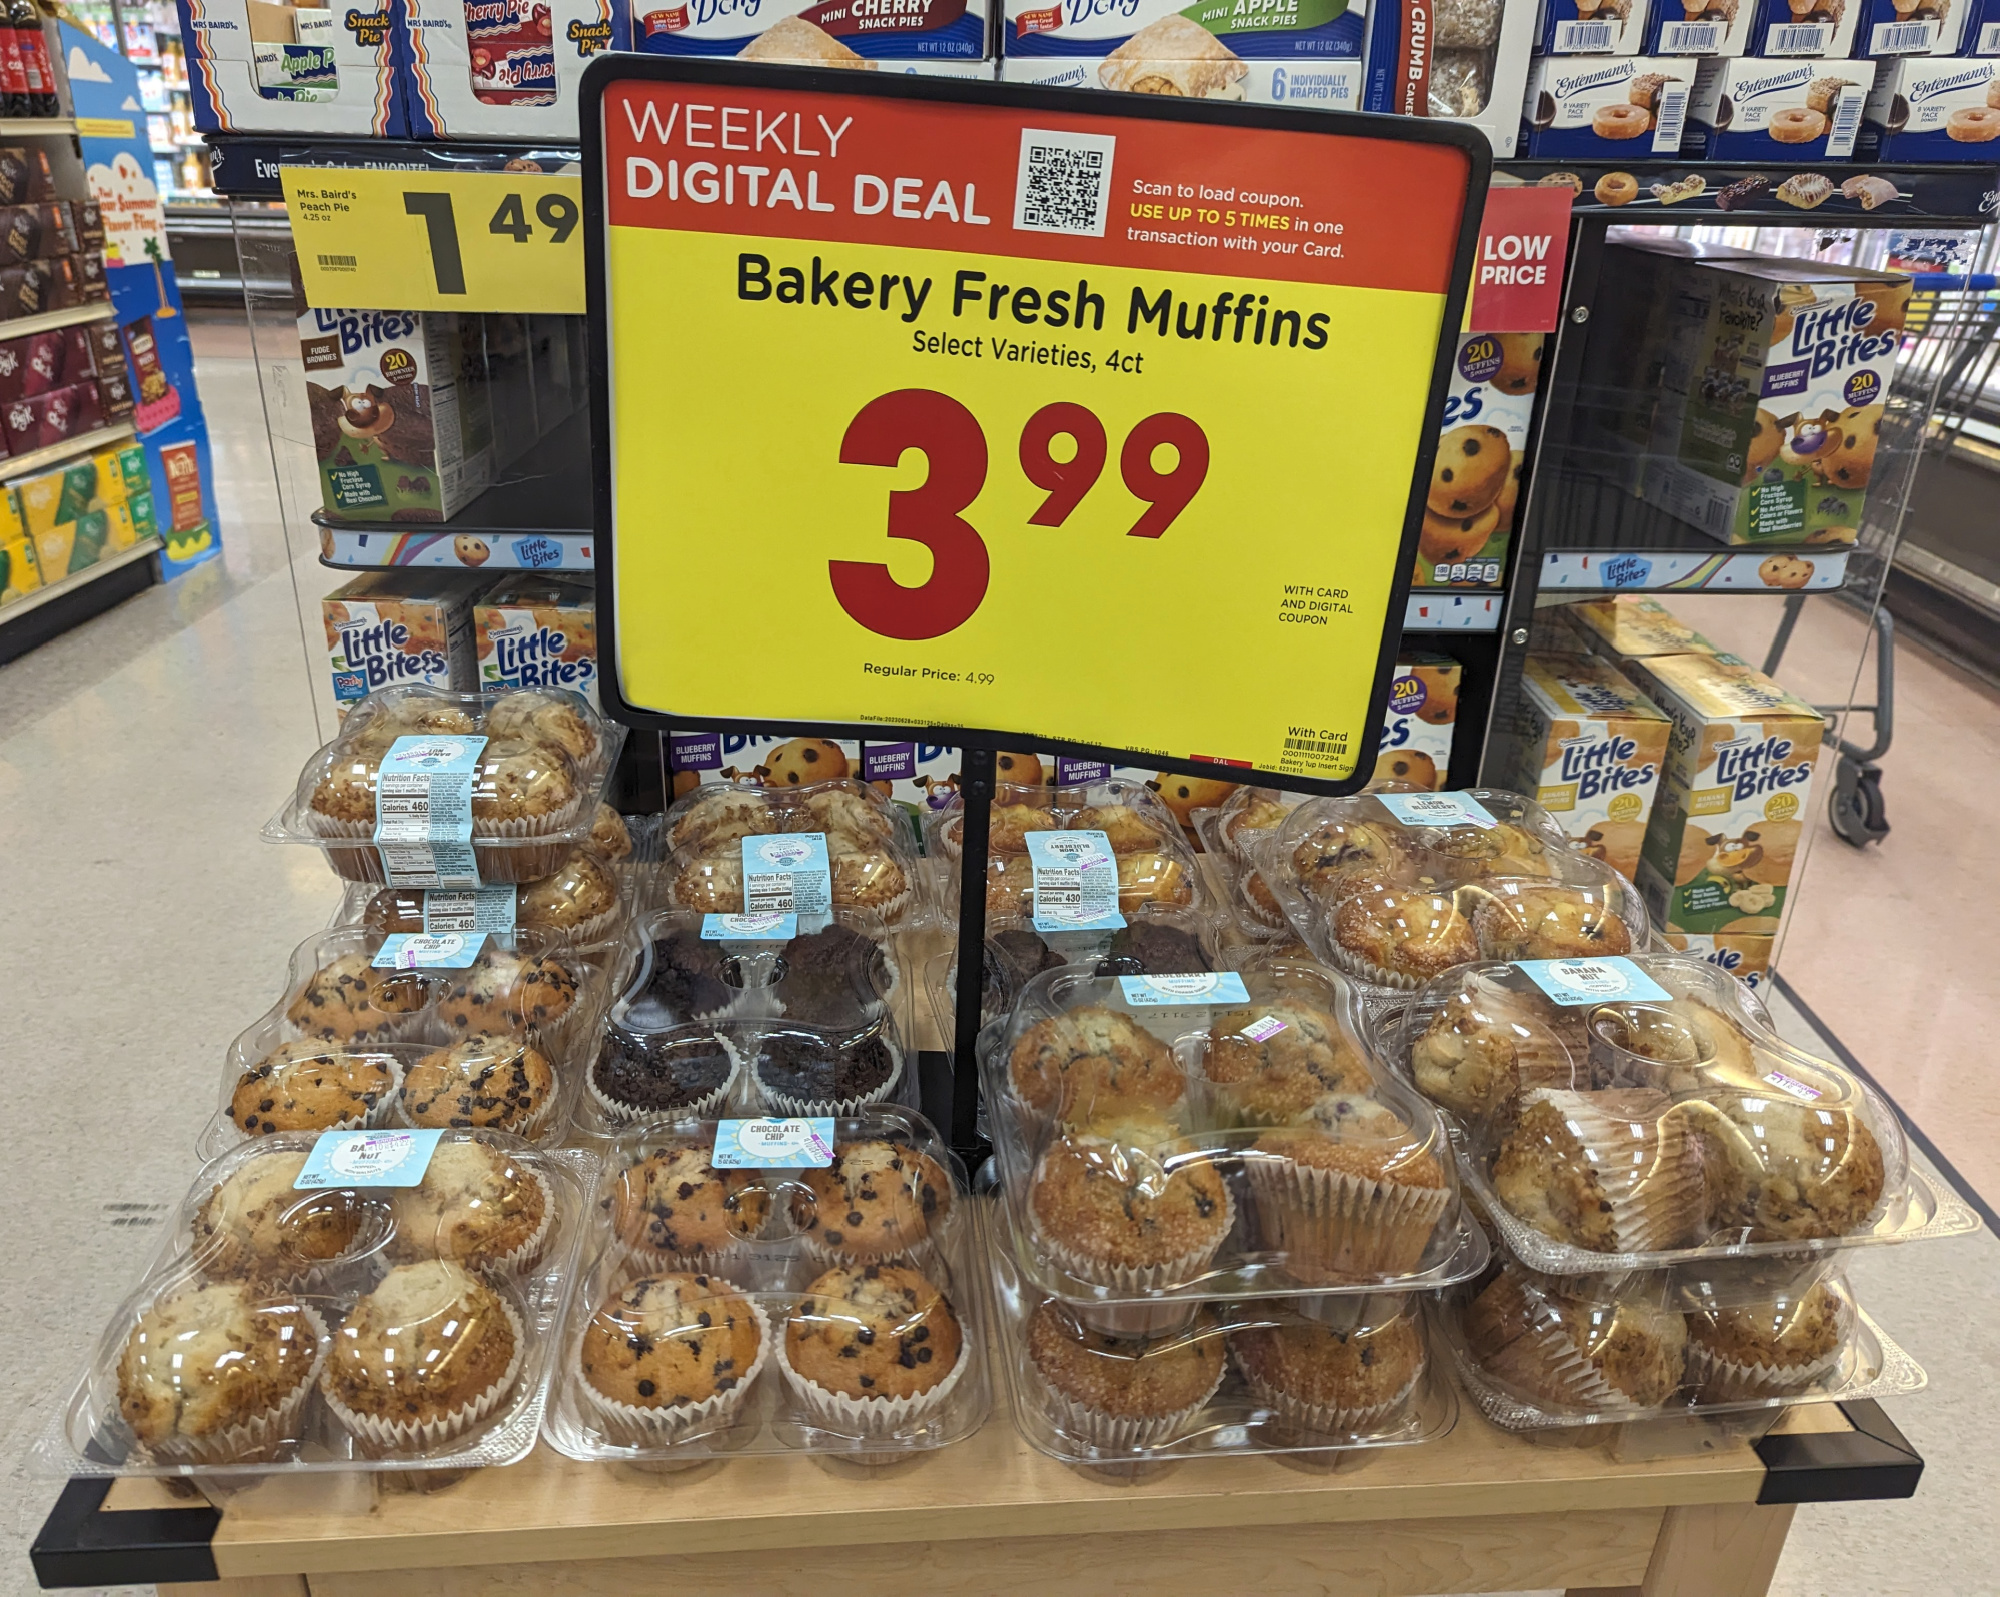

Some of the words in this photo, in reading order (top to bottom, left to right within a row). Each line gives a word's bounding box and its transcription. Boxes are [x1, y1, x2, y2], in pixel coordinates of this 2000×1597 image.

[506, 0, 530, 17] Pie
[820, 8, 846, 24] MINI
[851, 0, 933, 17] CHERRY
[1201, 7, 1229, 22] MINI
[1232, 0, 1298, 16] APPLE
[192, 21, 207, 29] MRS
[208, 21, 235, 30] BAIRD'S
[300, 22, 313, 30] MRS
[348, 13, 390, 29] Snack
[407, 19, 421, 28] MRS
[422, 20, 449, 29] BAIRD'S
[858, 17, 896, 30] SNACK
[899, 16, 924, 27] PIES
[1230, 16, 1269, 29] SNACK
[1272, 15, 1298, 26] PIES
[359, 29, 382, 44] Pie
[569, 22, 612, 39] Snack
[917, 43, 928, 53] NET
[929, 43, 938, 53] WT
[939, 43, 946, 53] 12
[947, 43, 955, 53] OZ
[956, 43, 975, 54] (340g)
[1294, 41, 1306, 51] NET
[1306, 41, 1316, 51] WT
[1317, 41, 1325, 51] 12
[1325, 41, 1334, 51] OZ
[1334, 41, 1353, 53] (340g)
[1409, 8, 1427, 80] CRUMB
[281, 53, 321, 76] Apple
[1290, 74, 1347, 86] INDIVIDUALLY
[1376, 68, 1386, 80] NET
[1555, 59, 1637, 99] Entenmann's
[1910, 61, 1996, 103] Entenmann's
[1271, 67, 1286, 101] 6
[1733, 63, 1815, 103] Entenmann's
[1289, 87, 1329, 99] WRAPPED
[1330, 87, 1349, 99] PIES
[1404, 82, 1417, 118] CAKES
[623, 98, 853, 158] WEEKLY
[297, 189, 319, 199] Mrs.
[321, 189, 357, 200] Baird's
[625, 156, 836, 213] DIGITAL
[853, 174, 991, 225] DEAL
[1132, 179, 1172, 196] Scan
[1177, 183, 1195, 198] to
[1198, 184, 1235, 203] load
[1239, 190, 1304, 209] coupon.
[300, 202, 331, 212] Peach
[333, 202, 350, 212] Pie
[303, 213, 320, 221] 4.25
[321, 214, 331, 222] oz
[1130, 203, 1164, 221] USE
[1168, 206, 1193, 222] UP
[1197, 208, 1220, 224] TO
[1225, 210, 1236, 227] 5
[1240, 212, 1290, 231] TIMES
[1294, 217, 1309, 232] in
[1313, 220, 1344, 236] one
[403, 191, 468, 296] 1
[488, 194, 580, 244] 49
[1126, 227, 1218, 248] transaction
[1223, 234, 1258, 250] with
[1261, 239, 1299, 257] your
[1303, 240, 1345, 260] Card.
[1483, 235, 1552, 261] LOW
[1480, 265, 1547, 285] PRICE
[737, 252, 932, 324] Bakery
[952, 269, 1106, 331] Fresh
[1127, 286, 1331, 350] Muffins
[340, 310, 415, 355] Bites
[1792, 298, 1875, 358] Little
[310, 345, 331, 355] FUDGE
[912, 330, 983, 359] Select
[991, 338, 1098, 373] Varieties,
[1105, 349, 1144, 375] 4ct
[1467, 340, 1494, 364] 20
[1810, 330, 1895, 380] Bites
[306, 353, 337, 364] BROWNIES
[385, 352, 408, 371] 20
[1463, 357, 1500, 373] MUFFINS
[1769, 369, 1806, 382] BLUEBERRY
[1851, 373, 1874, 392] 20
[1771, 378, 1799, 390] MUFFINS
[1848, 386, 1879, 399] MUFFINS
[828, 388, 990, 641] 3
[1019, 401, 1210, 540] 99
[520, 538, 548, 561] Little
[530, 548, 560, 568] Bites
[1607, 556, 1638, 580] Little
[1614, 565, 1648, 588] Bites
[1284, 584, 1314, 597] WITH
[1316, 587, 1349, 599] CARD
[1280, 598, 1306, 610] AND
[1309, 601, 1354, 614] DIGITAL
[1278, 612, 1328, 626] COUPON
[342, 619, 409, 668] Little
[496, 627, 565, 676] Little
[520, 659, 593, 687] Bites
[863, 662, 918, 678] Regular
[922, 667, 961, 682] Price:
[965, 671, 995, 686] 4.99
[336, 674, 364, 689] Party
[1393, 679, 1418, 699] 20
[1391, 693, 1425, 707] MUFFINS
[1288, 726, 1316, 739] With
[1319, 729, 1349, 742] Card
[676, 742, 716, 756] BLUEBERRY
[1282, 749, 1340, 762] 0001111007294
[680, 752, 712, 764] MUFFINS
[869, 752, 910, 766] BLUEBERRY
[1213, 757, 1230, 766] DAL
[1280, 757, 1304, 768] Bakery
[1318, 762, 1338, 771] Insert
[1338, 763, 1354, 773] Sign
[1561, 736, 1636, 782] Little
[1716, 736, 1792, 784] Little
[874, 761, 906, 774] MUFFINS
[1068, 769, 1101, 781] MUFFINS
[382, 773, 411, 782] Nutrition
[412, 773, 430, 782] Facts
[1578, 764, 1653, 800] Bites
[1733, 762, 1810, 802] Bites
[382, 803, 409, 811] Calories
[411, 801, 429, 811] 460
[1616, 797, 1635, 810] 20
[1771, 795, 1793, 810] 20
[748, 874, 775, 882] Nutrition
[775, 873, 792, 881] Facts
[1038, 868, 1064, 876] Nutrition
[1064, 868, 1080, 876] Facts
[430, 892, 457, 901] Nutrition
[458, 892, 475, 900] Facts
[750, 902, 774, 910] Calories
[778, 898, 793, 908] 460
[1039, 895, 1062, 903] Calories
[1065, 893, 1080, 903] 430
[430, 922, 455, 930] Calories
[458, 919, 475, 929] 460
[1560, 966, 1607, 975] BANANA
[1579, 973, 1601, 981] NUT
[750, 1125, 801, 1133] CHOCOLATE
[764, 1133, 785, 1141] CHIP
[358, 1152, 382, 1160] NUT
